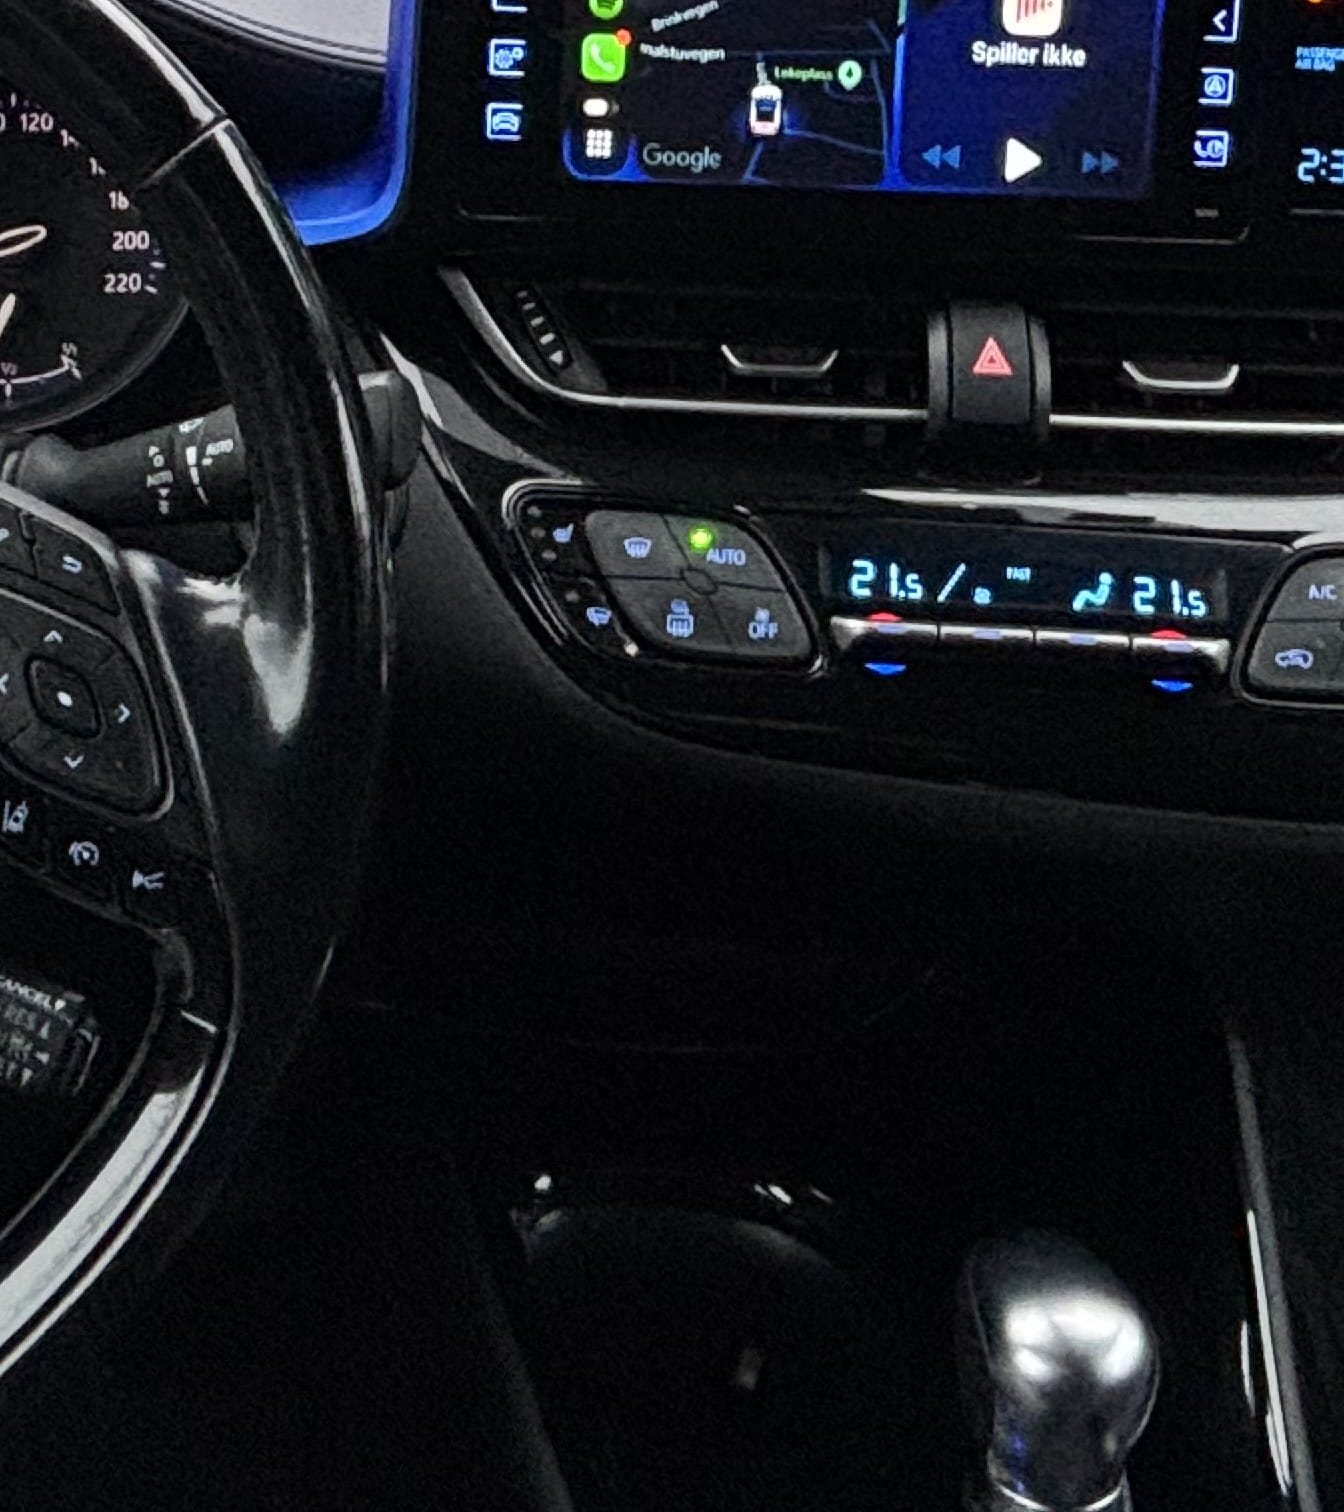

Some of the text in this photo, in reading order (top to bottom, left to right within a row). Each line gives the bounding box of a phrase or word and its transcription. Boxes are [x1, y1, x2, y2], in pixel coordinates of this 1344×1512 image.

[971, 41, 1086, 68] Spiller ikke
[20, 112, 54, 133] 120
[642, 142, 722, 174] Google
[112, 231, 150, 251] 200
[104, 272, 142, 294] 220
[706, 548, 746, 566] AUTO
[850, 558, 923, 601] 21.5
[1132, 575, 1207, 617] 21.5
[1308, 584, 1338, 600] A/C
[748, 622, 778, 639] OFF
